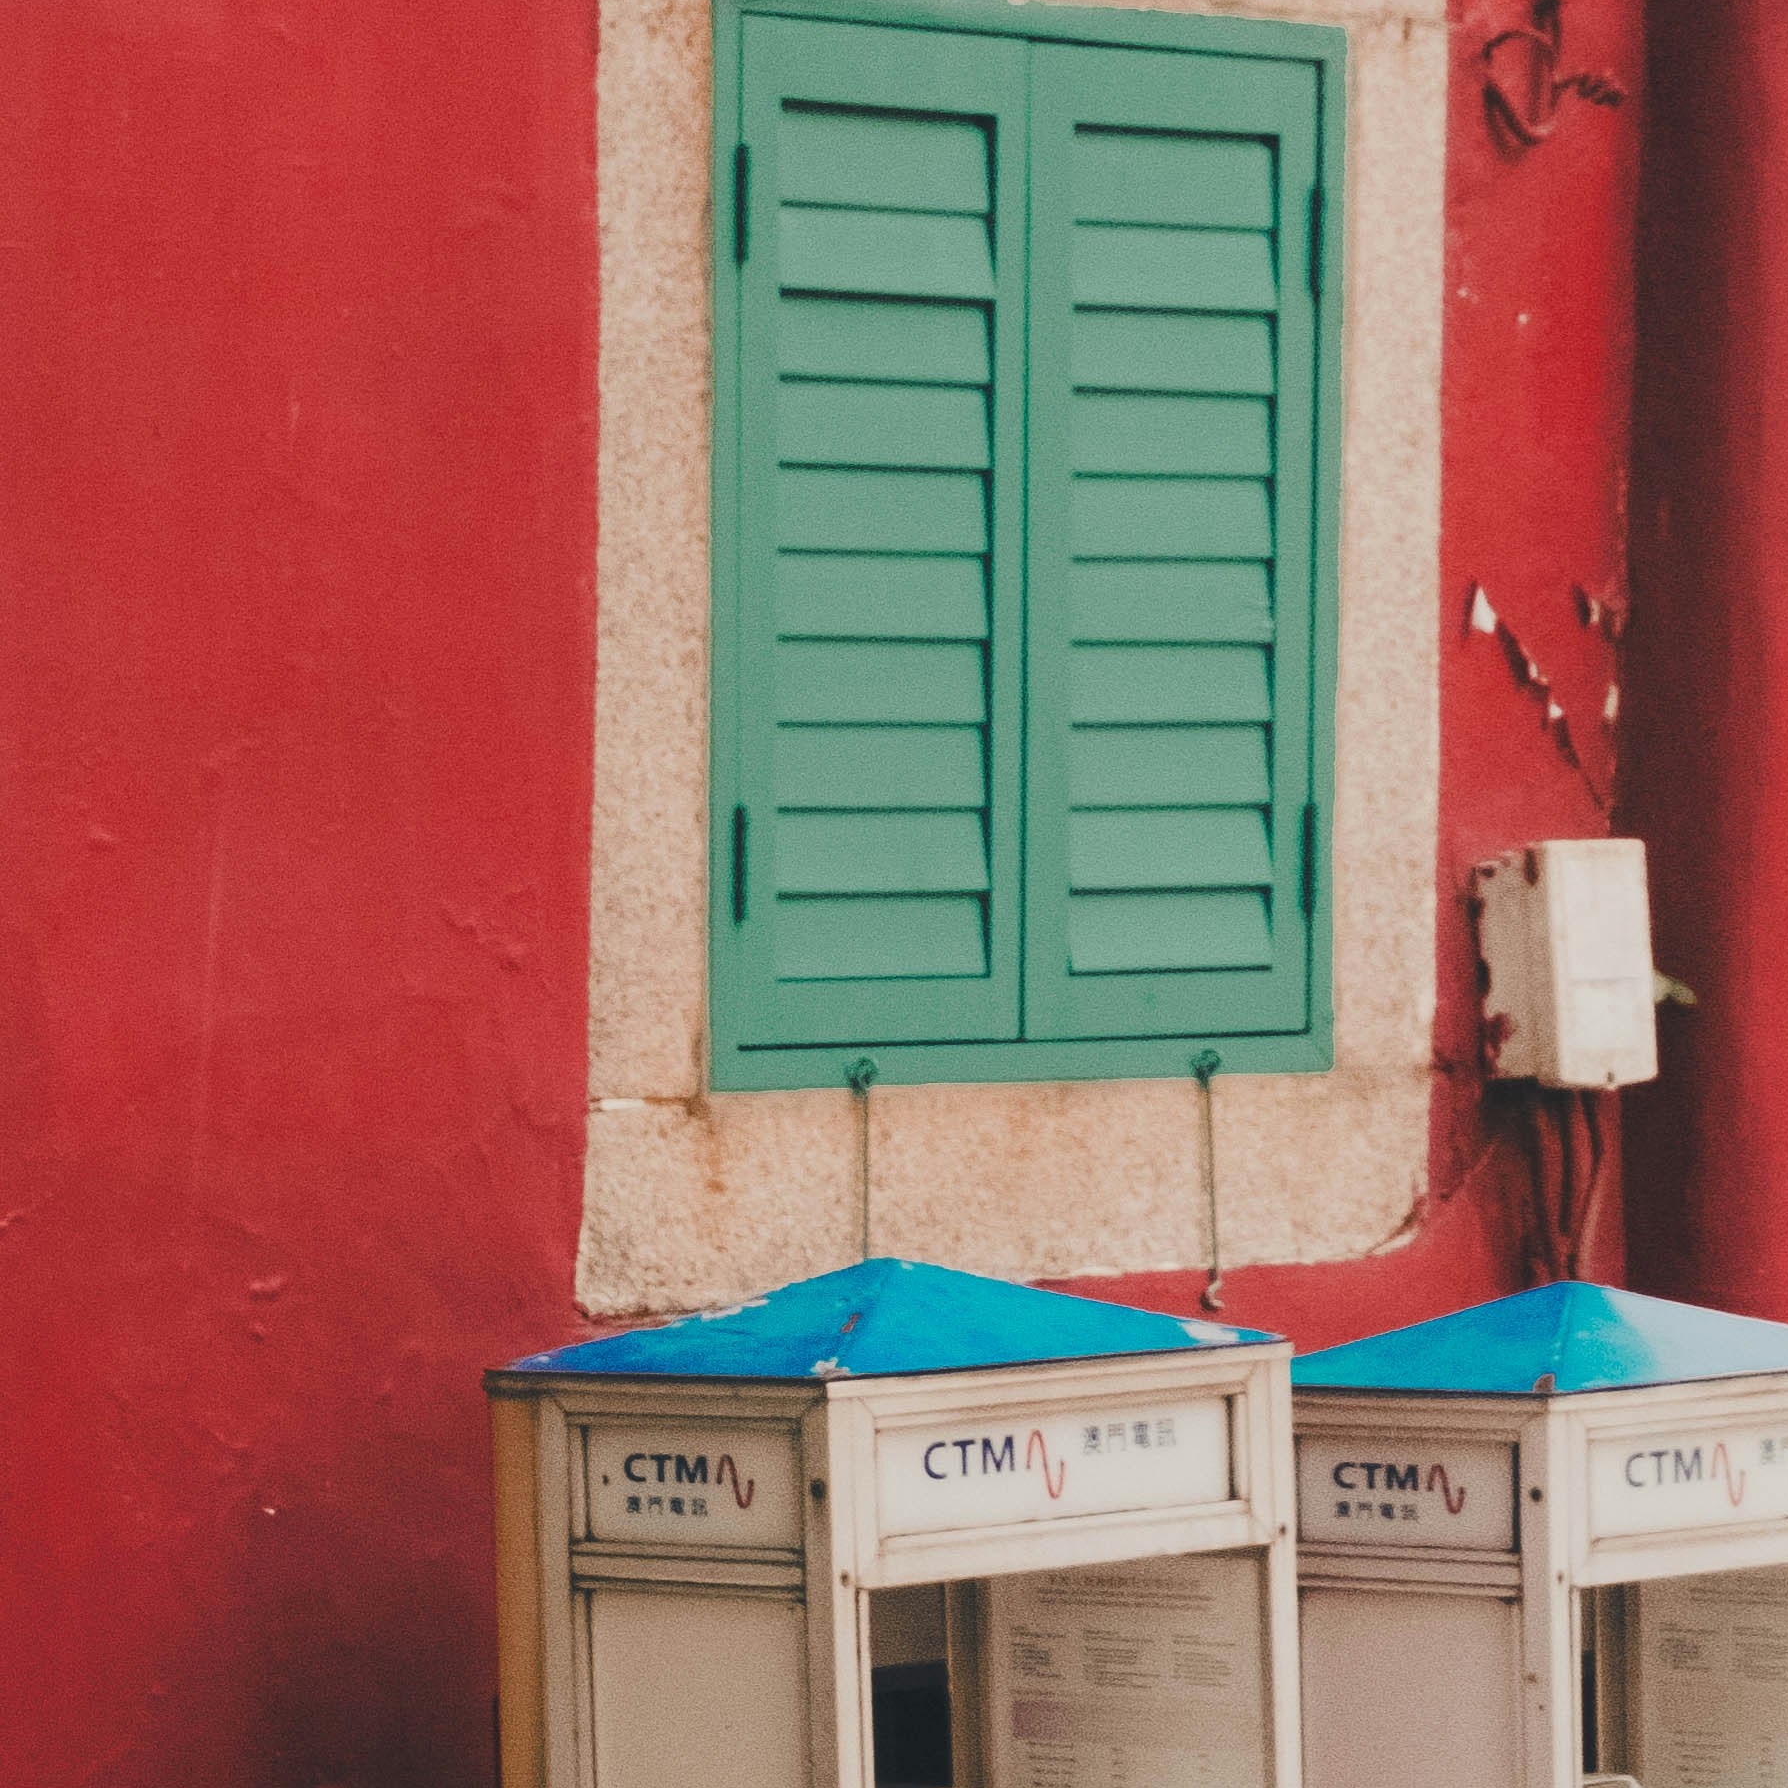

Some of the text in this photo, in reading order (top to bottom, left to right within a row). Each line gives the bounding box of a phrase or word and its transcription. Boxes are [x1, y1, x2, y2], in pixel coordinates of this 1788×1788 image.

[624, 1452, 709, 1485] CTM
[924, 1434, 1016, 1480] CTM
[1624, 1445, 1703, 1488] CTM
[1332, 1461, 1420, 1492] CTM
